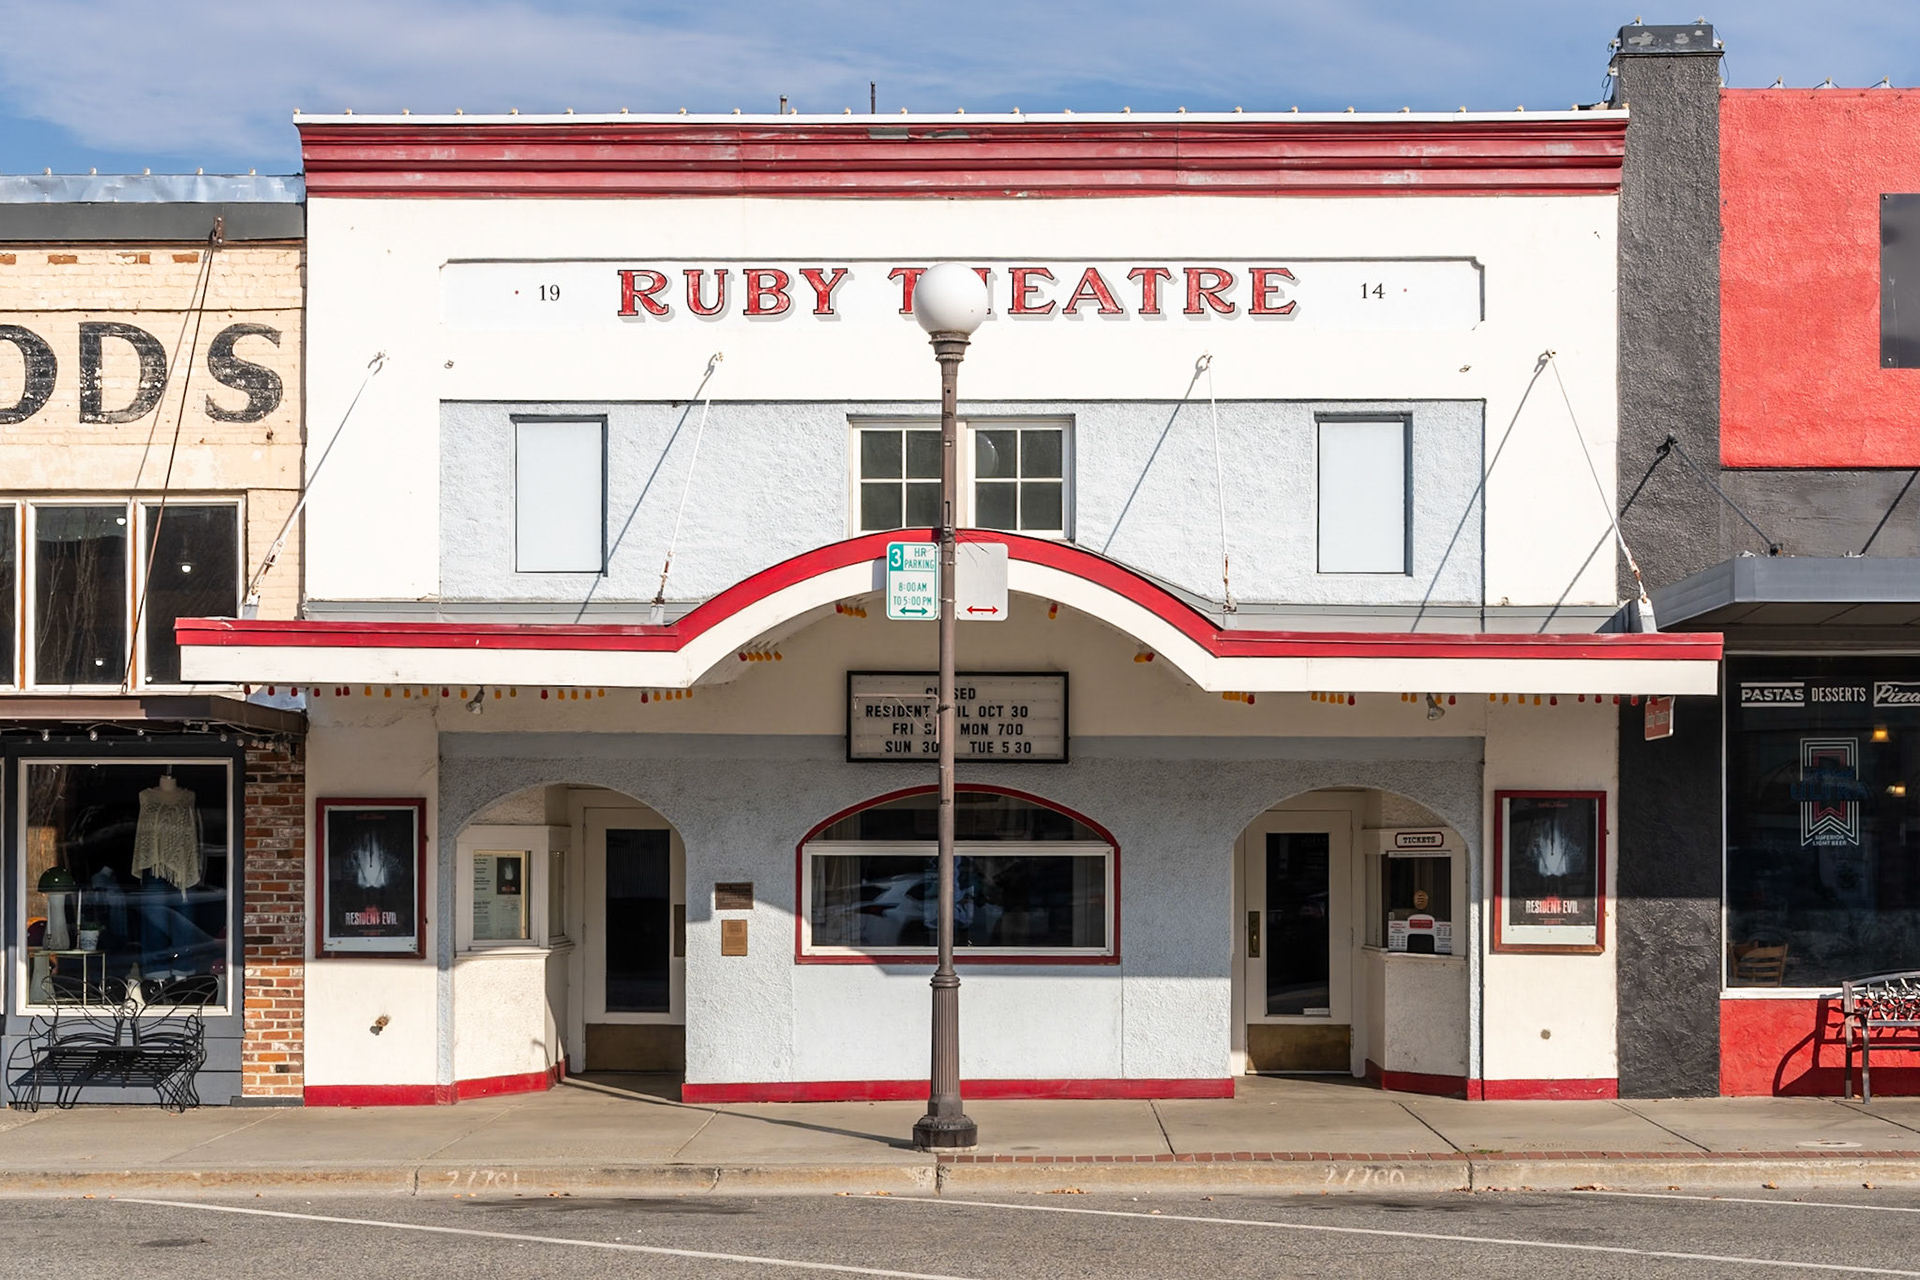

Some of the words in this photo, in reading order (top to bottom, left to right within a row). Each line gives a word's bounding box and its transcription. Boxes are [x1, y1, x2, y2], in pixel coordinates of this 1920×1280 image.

[539, 284, 561, 301] 19
[617, 267, 850, 317] RUBY
[887, 266, 1298, 316] TEATRE
[1360, 282, 1386, 300] 14
[890, 548, 902, 568] 3
[914, 547, 927, 557] HR
[904, 559, 935, 569] PARKING
[898, 582, 916, 592] 8:00
[917, 582, 927, 592] AM
[893, 596, 902, 606] TO
[903, 596, 920, 606] 5:00
[922, 596, 932, 606] PM
[925, 687, 976, 700] CLSED
[1741, 688, 1805, 701] PASTAS
[1811, 687, 1867, 702] DESSERTS
[865, 705, 931, 718] RESIDENT
[978, 705, 1004, 718] OCT
[1011, 706, 1029, 718] 30
[892, 723, 914, 735] FRI
[960, 723, 989, 736] MON
[998, 723, 1023, 736] 700
[885, 741, 912, 753] SUN
[970, 741, 994, 753] TUE
[1402, 836, 1437, 844] TICKETS
[1525, 900, 1561, 914] RESIDENT
[1562, 899, 1580, 914] EVIL
[345, 911, 380, 926] RESIDENT
[381, 911, 399, 925] EVIL
